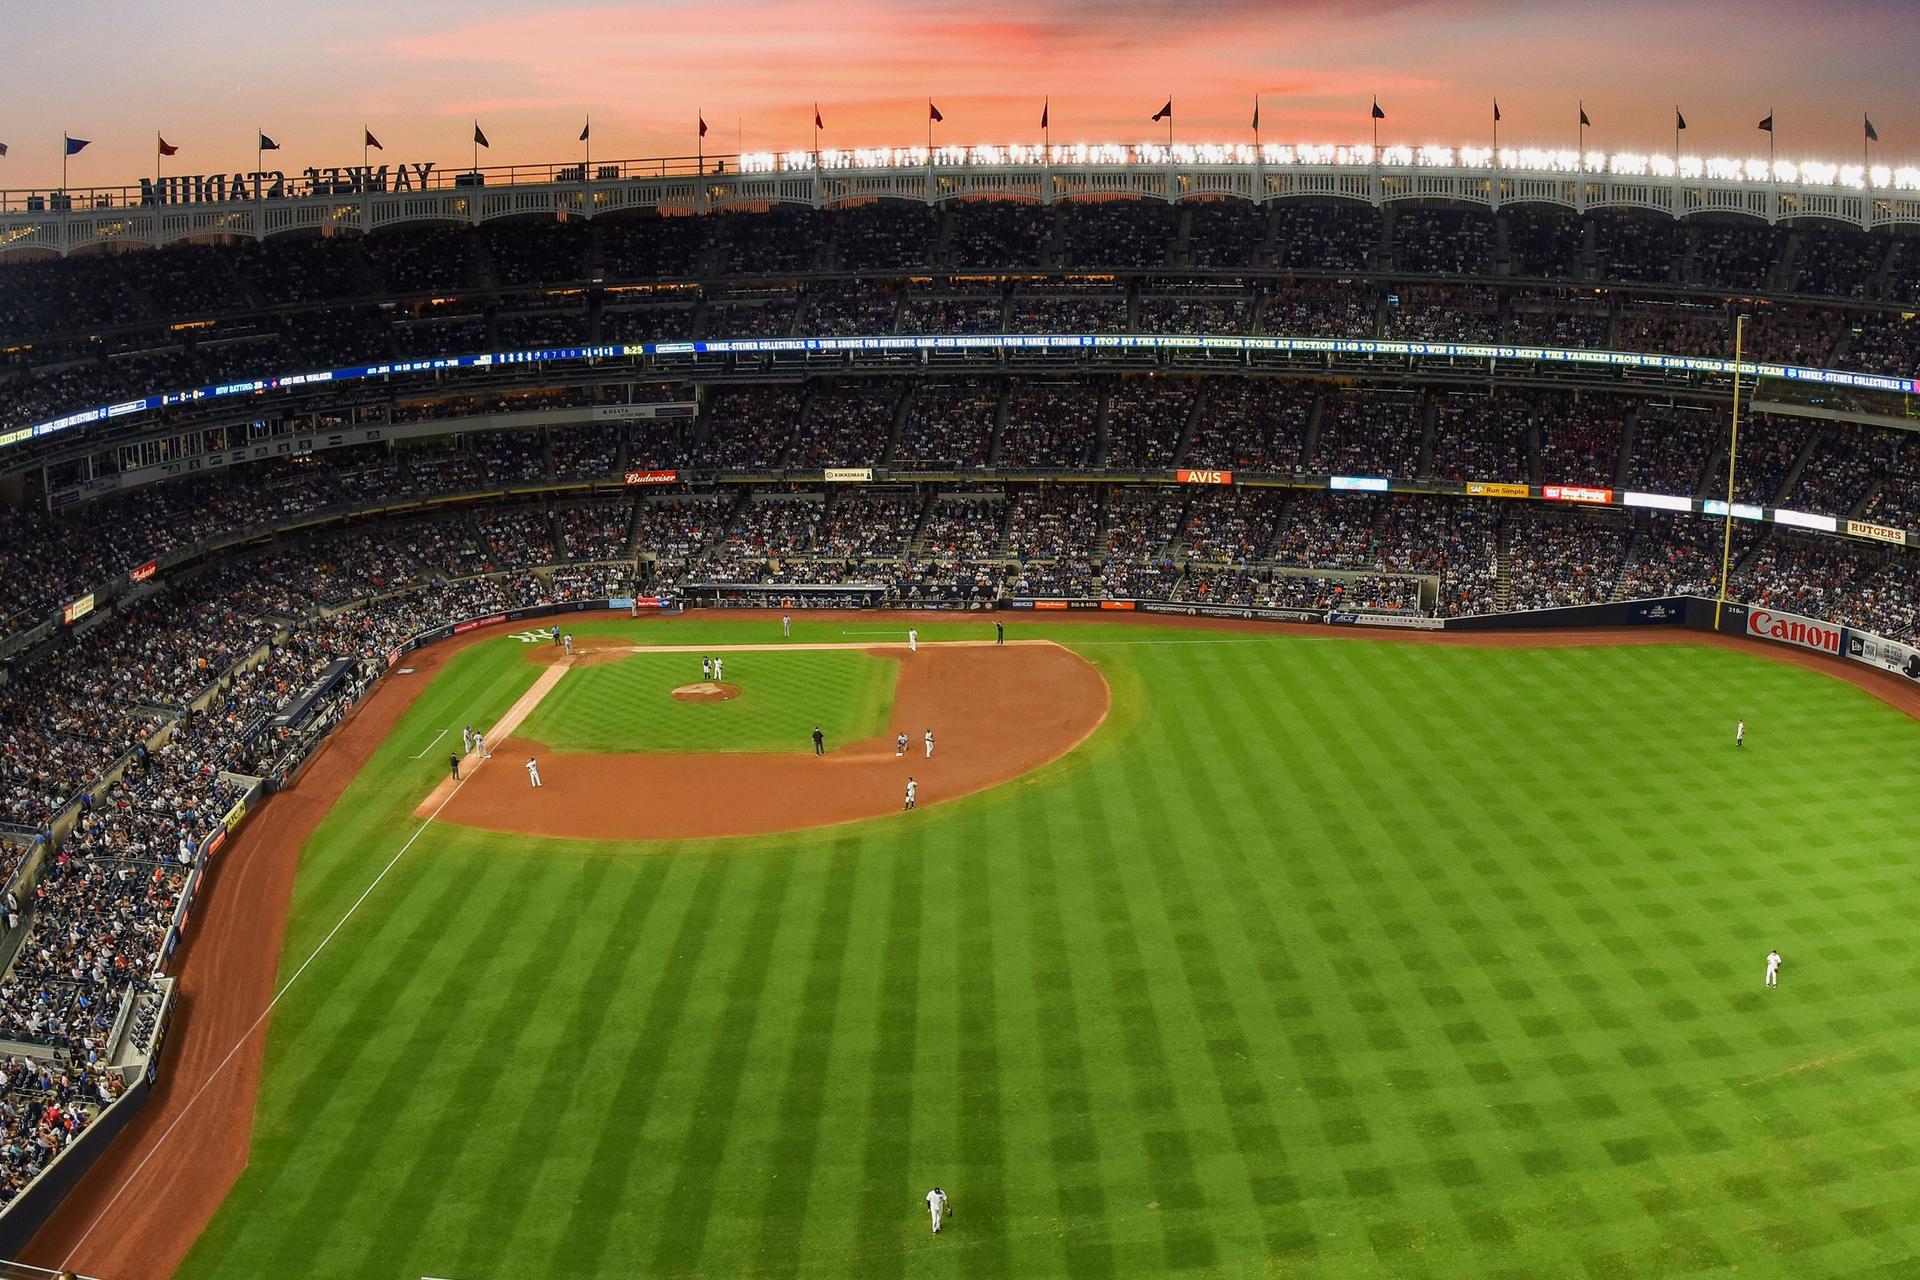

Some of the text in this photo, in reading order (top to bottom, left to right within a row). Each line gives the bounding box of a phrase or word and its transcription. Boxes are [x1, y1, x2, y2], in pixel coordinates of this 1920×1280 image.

[706, 340, 806, 351] YANKEE-STEINER COLLECTIBLES
[818, 337, 1081, 349] YOUR SOURCE FOR AUTHENTIC GAME-USED MEMORABILIA FROM YANKEE STADIUM
[624, 345, 643, 354] 8:25
[1094, 337, 1120, 346] STOP
[1121, 337, 1134, 346] BY
[1136, 337, 1155, 346] THE
[1156, 338, 1243, 348] YANKEES-STEINER
[1244, 338, 1276, 349] STORE
[1277, 340, 1290, 349] AT
[1292, 340, 1334, 350] SECTION
[1336, 340, 1360, 351] 114B
[1361, 342, 1374, 352] TO
[1376, 342, 1408, 352] ENTER
[1410, 343, 1425, 353] TO
[1426, 344, 1446, 354] WIN
[1448, 346, 1454, 354] 2
[1456, 346, 1498, 356] TICKETS
[1500, 348, 1514, 357] TO
[1516, 348, 1544, 358] MEET
[1546, 350, 1565, 360] THE
[1566, 351, 1610, 362] YANKEES
[1612, 353, 1641, 364] FROM
[1643, 355, 1662, 366] THE
[1686, 359, 1722, 370] WORLD
[1758, 365, 1785, 376] TEAM
[292, 376, 305, 384] NEIL
[306, 372, 332, 382] WALKER
[1798, 370, 1900, 390] YANKEE-STEINER COLLECTIBLES
[180, 392, 186, 402] S
[624, 472, 676, 484] Budweiser
[1188, 472, 1222, 483] AVIS
[1501, 488, 1525, 496] Simple
[1851, 522, 1902, 540] RUTGERS
[1750, 610, 1839, 651] Canon
